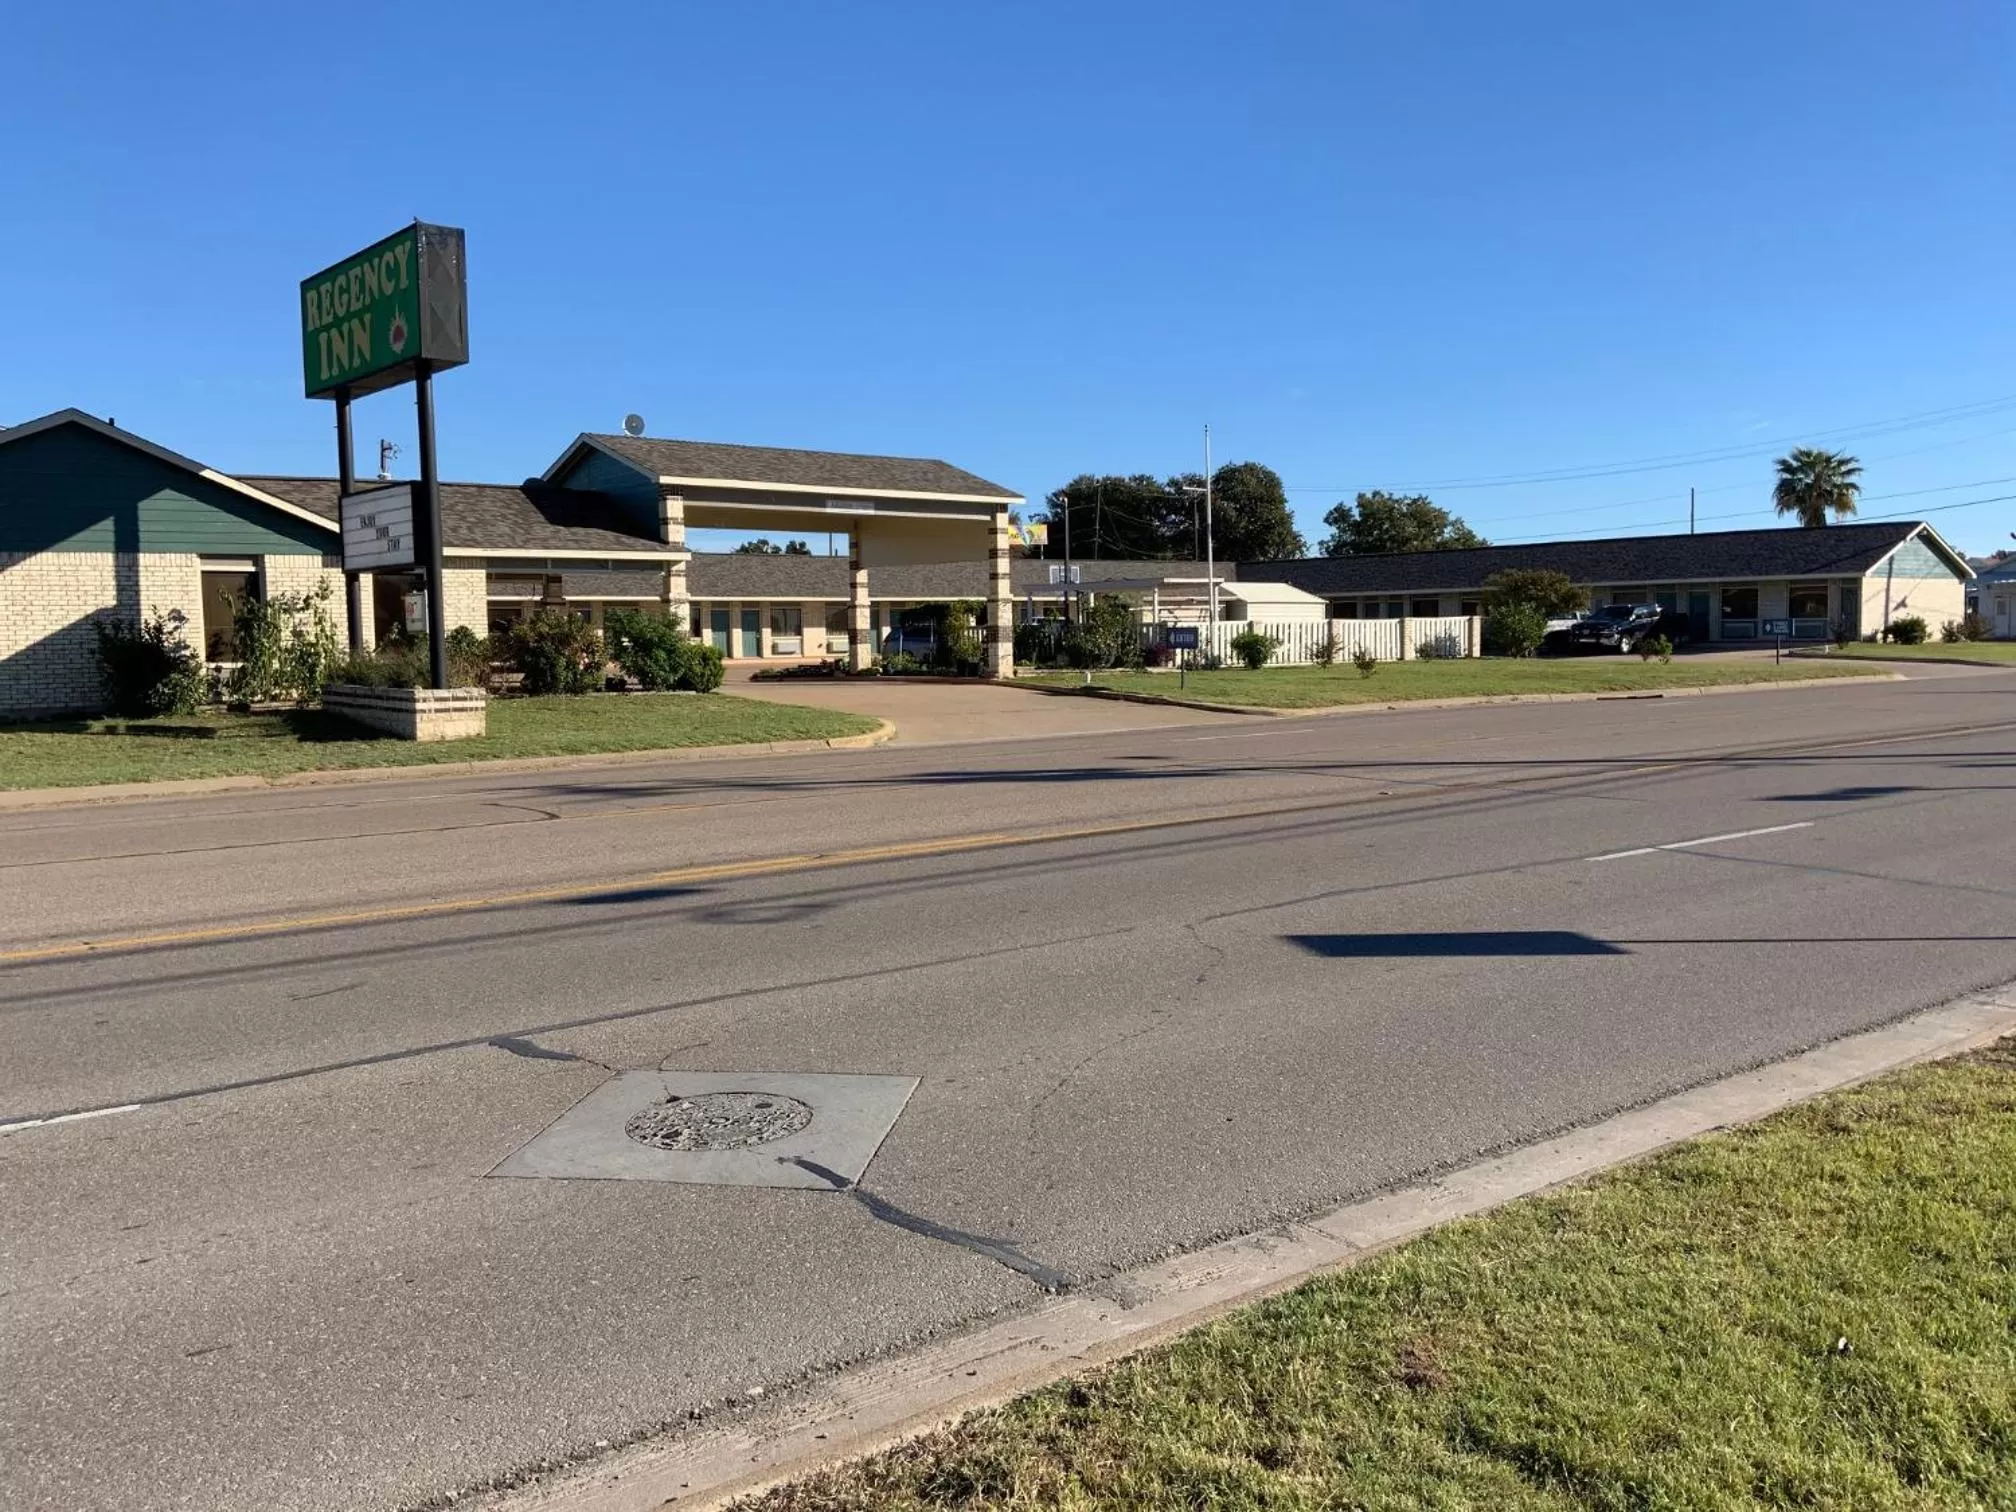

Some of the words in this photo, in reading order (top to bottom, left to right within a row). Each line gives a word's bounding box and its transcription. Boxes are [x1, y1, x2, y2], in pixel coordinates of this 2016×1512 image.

[306, 242, 411, 331] REGENCY
[318, 313, 372, 381] INN
[359, 513, 376, 529] ENJOY
[387, 538, 400, 553] STAY
